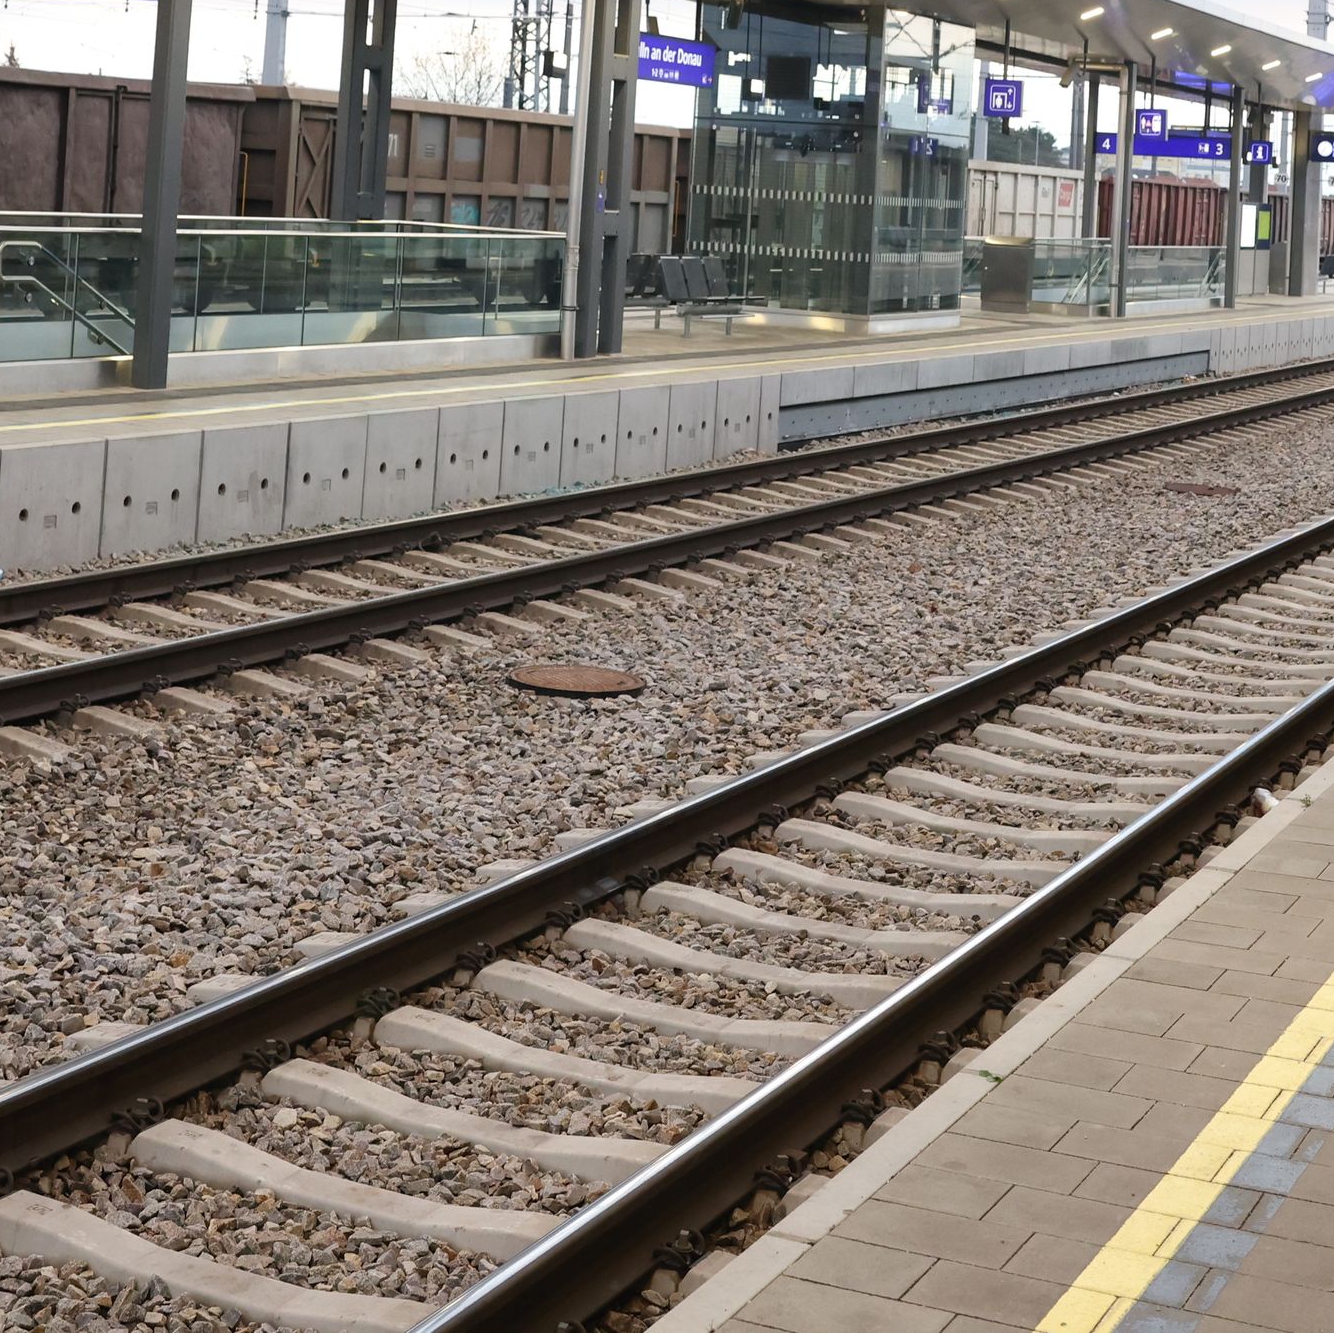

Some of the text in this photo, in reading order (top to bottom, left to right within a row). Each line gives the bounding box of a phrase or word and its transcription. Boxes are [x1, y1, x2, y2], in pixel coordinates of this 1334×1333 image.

[639, 41, 702, 66] lln an der Donau
[1102, 138, 1224, 155] 4 3
